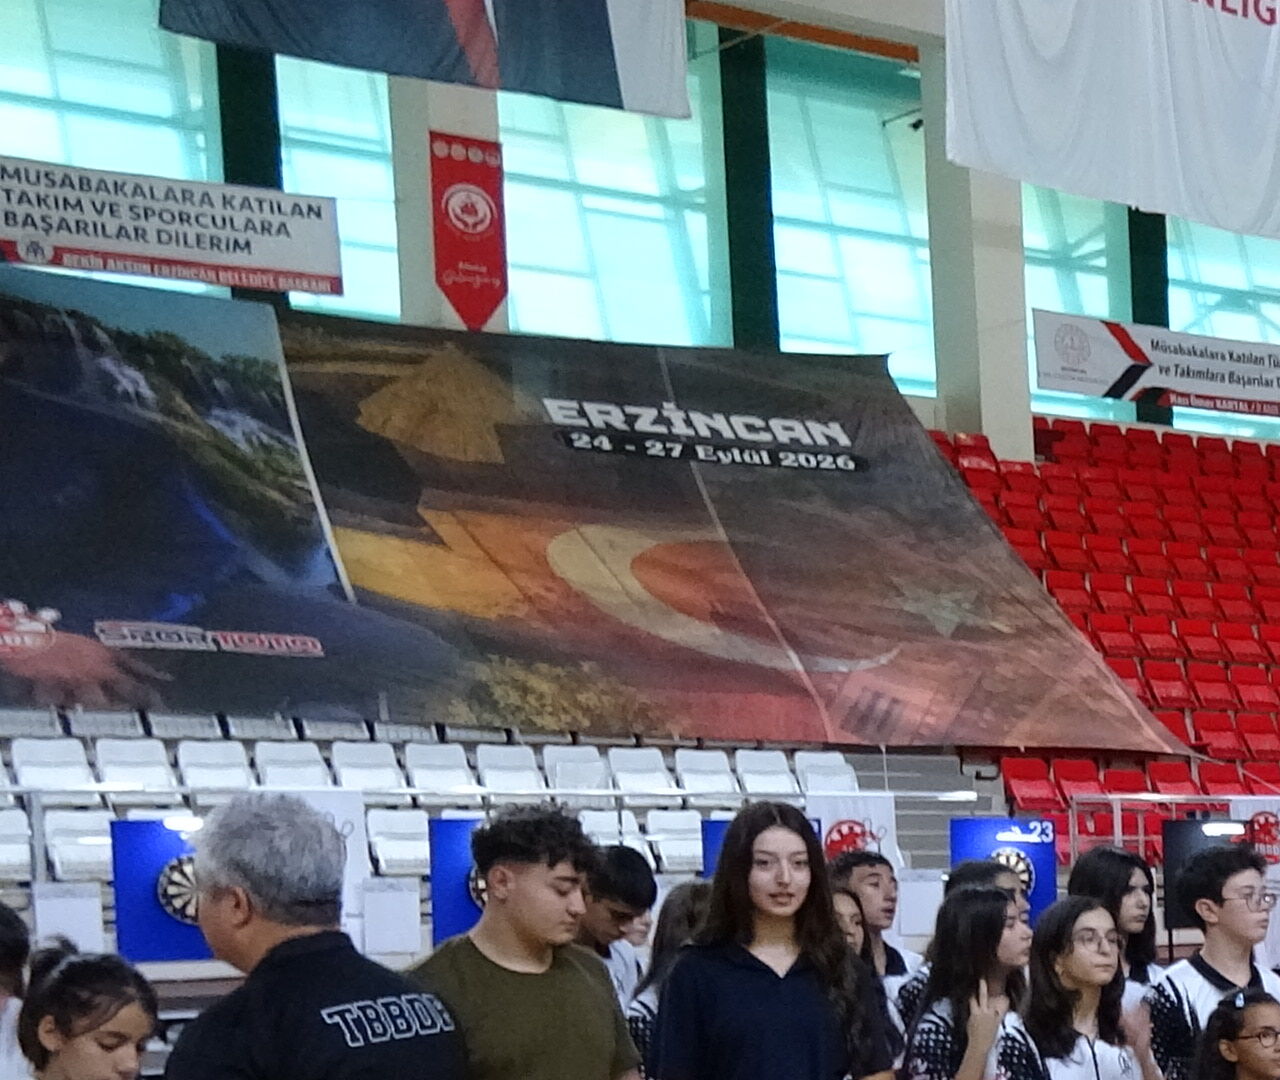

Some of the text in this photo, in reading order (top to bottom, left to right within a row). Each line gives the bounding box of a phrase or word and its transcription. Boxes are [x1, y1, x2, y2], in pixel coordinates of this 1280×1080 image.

[2, 188, 292, 239] TAKIM VE SPORCULARA
[222, 192, 322, 220] KATILAN
[4, 210, 149, 243] BAŞARILAR
[1150, 338, 1226, 362] Müsabakalara
[1158, 364, 1171, 376] ve
[1174, 363, 1225, 384] Takımlara
[542, 398, 852, 447] ERZİNCAN
[570, 432, 612, 450] 24
[645, 440, 683, 458] 27
[695, 444, 771, 466] Eylül
[777, 451, 855, 471] 2026
[1028, 820, 1054, 843] 23
